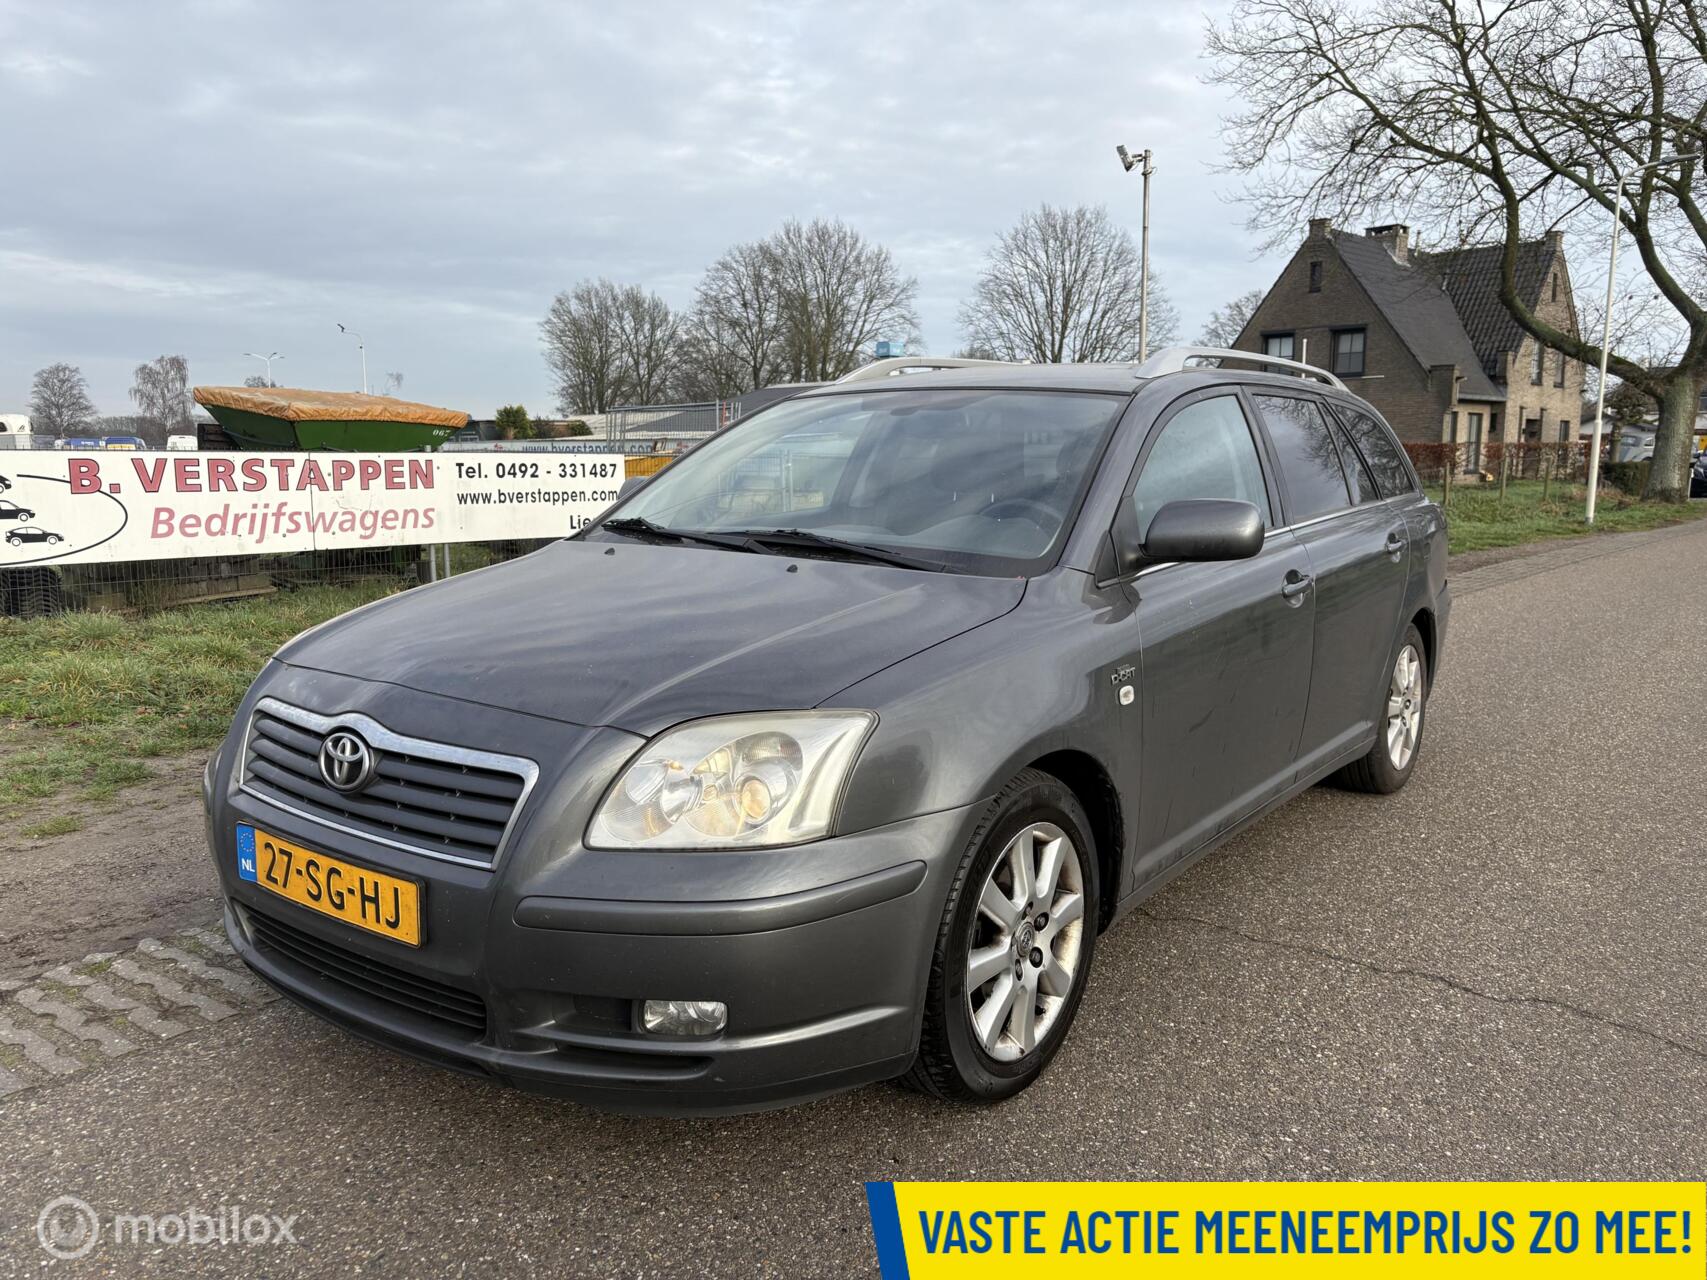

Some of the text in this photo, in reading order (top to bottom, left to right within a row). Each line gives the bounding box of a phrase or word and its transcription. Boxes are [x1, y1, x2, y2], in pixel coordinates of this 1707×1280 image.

[68, 458, 435, 495] B. VERSTAPPEN
[455, 462, 488, 479] Tel.
[495, 462, 539, 478] 0492
[558, 463, 617, 478] 331487
[456, 488, 618, 506] www.bverstappen.com
[150, 502, 435, 544] Bedrijfswagens
[241, 857, 256, 874] NL
[263, 841, 401, 930] 27-SG-HJ
